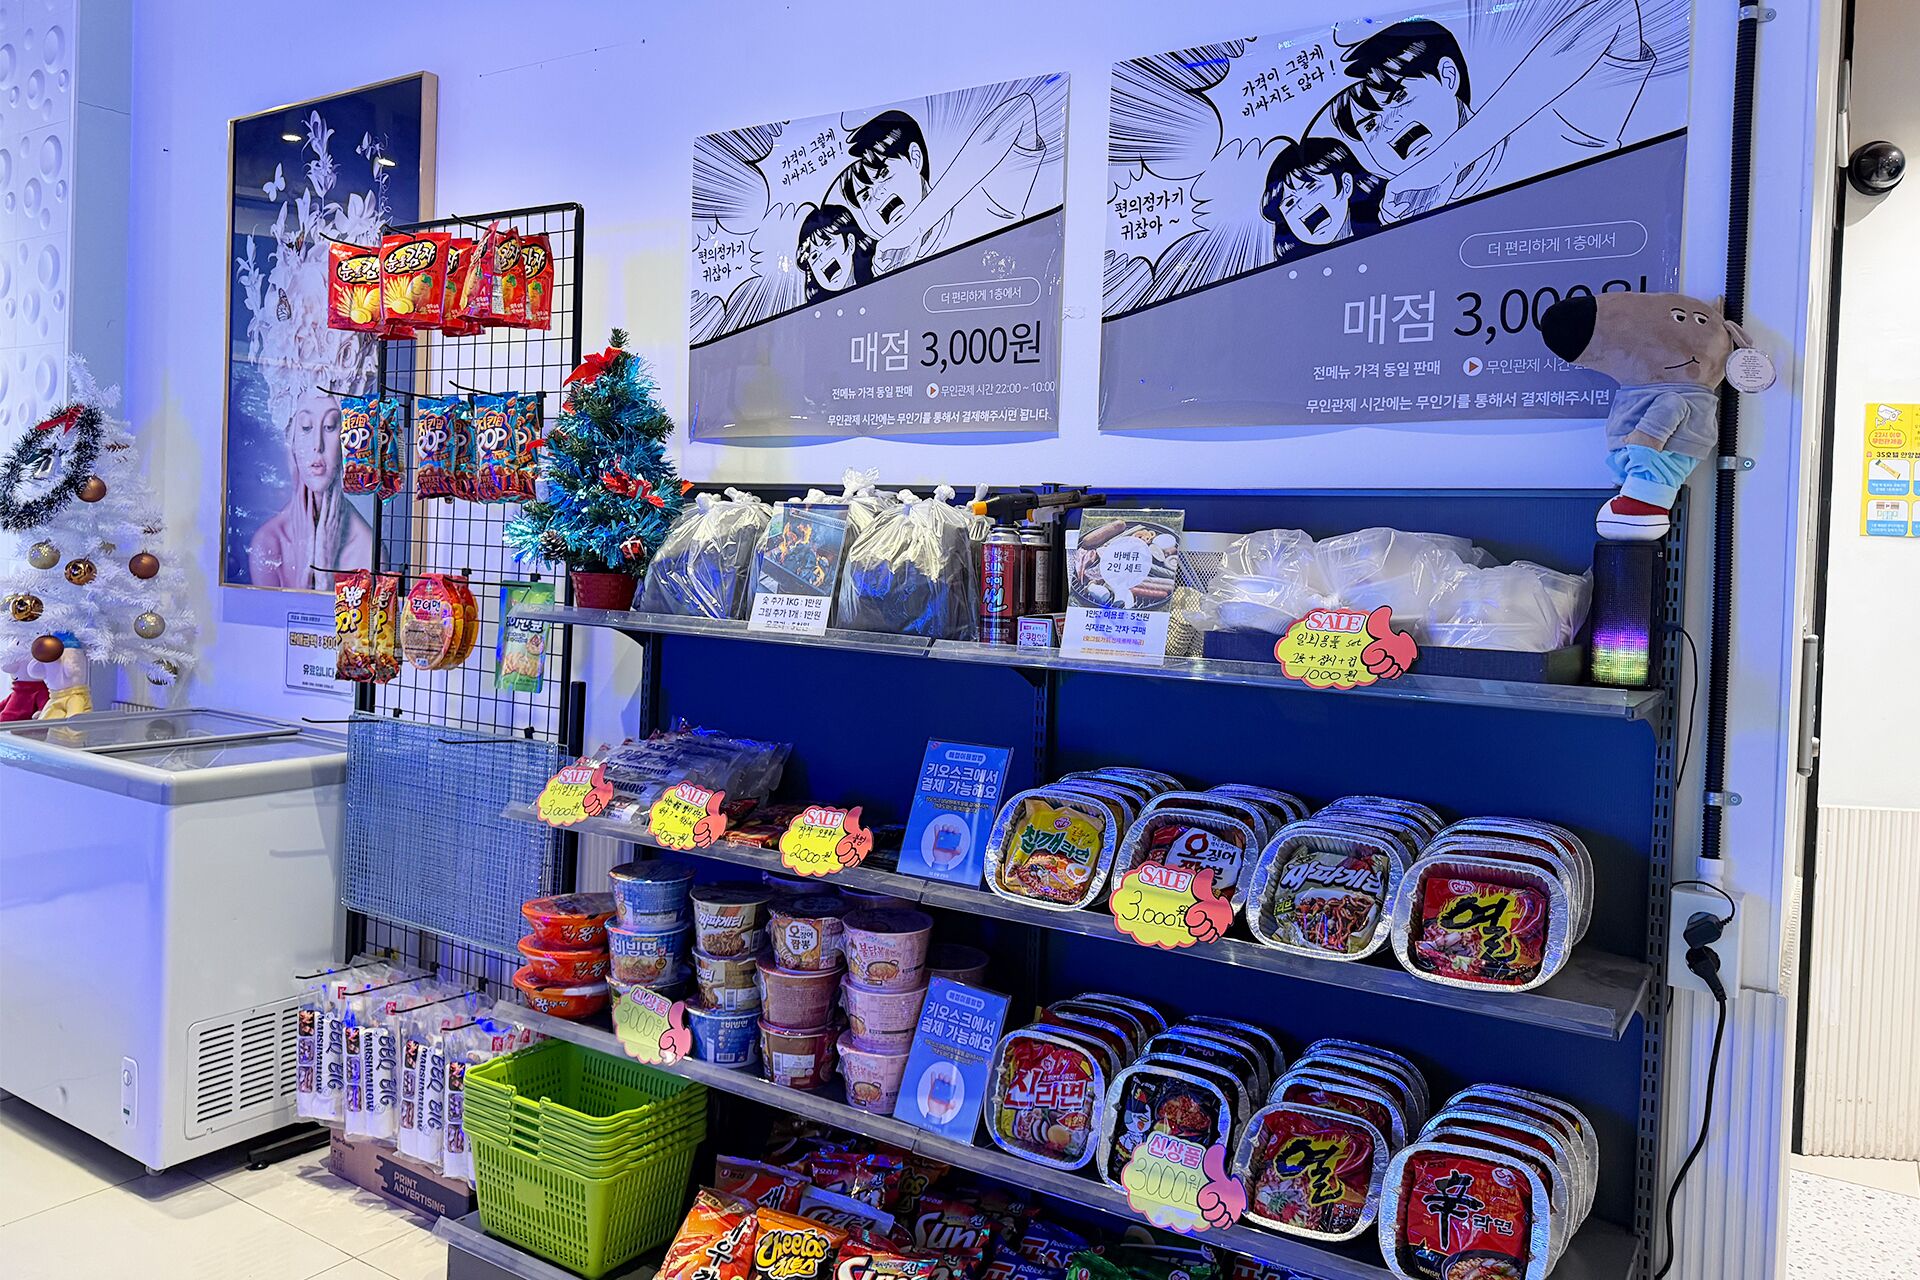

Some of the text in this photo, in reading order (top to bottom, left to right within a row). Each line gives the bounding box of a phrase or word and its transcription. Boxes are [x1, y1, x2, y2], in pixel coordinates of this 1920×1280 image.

[1242, 44, 1325, 98] 가격이 그렇게
[1242, 85, 1295, 118] 비싸지도
[781, 130, 837, 170] 가격이 그렇게
[782, 162, 817, 186] 비싸지도
[1114, 187, 1184, 219] 편의점가기
[1121, 216, 1163, 241] 귀찮아
[698, 240, 746, 265] 편의점가기
[1488, 232, 1618, 257] 더 편리하게 1층에서
[384, 243, 437, 273] 눈을감자
[703, 263, 732, 283] 귀찮아
[941, 287, 1022, 304] 더 편리하게 1층에서
[1344, 290, 1437, 346] 매점
[850, 321, 1042, 374] 매점 3,000원
[1313, 366, 1352, 382] 전메뉴
[1354, 364, 1381, 379] 가격
[1382, 362, 1411, 378] 동일
[1413, 360, 1441, 376] 판매
[1486, 358, 1541, 375] 무인관제
[831, 380, 1056, 400] 전메뉴 가격 동일 판매 무인관제 시간 22:00 10:00
[1306, 388, 1611, 414] 무인관제 시간에는 무인기를 통해서 결제해주시면
[827, 413, 861, 427] 무인관제
[862, 412, 896, 426] 시간에는
[897, 411, 932, 425] 무인기를
[932, 410, 961, 424] 통해서
[962, 408, 1018, 423] 결제해주시면
[1107, 563, 1142, 573] 2인 세트
[1113, 551, 1140, 562] 바베큐
[1309, 613, 1361, 631] SALE
[560, 771, 590, 782] SALE
[926, 763, 999, 784] 키오스크에서
[677, 786, 708, 805] SALE
[921, 777, 998, 799] 결제 가능해요
[805, 810, 844, 827] SALE
[1020, 823, 1091, 864] 참깨라면
[1177, 833, 1237, 866] 오징어
[1140, 866, 1188, 891] SALE
[698, 911, 745, 929] 짜파게티
[788, 925, 813, 939] 오징어
[614, 940, 657, 957] 비빔면
[926, 1001, 996, 1036] 키오스크에서
[921, 1016, 945, 1037] 결제
[946, 1024, 994, 1053] 가능해요
[364, 1031, 375, 1112] MARSHMALLOW
[1004, 1068, 1087, 1109] 진라면
[1149, 1134, 1203, 1169] 신상품
[393, 1171, 418, 1188] PRINT
[393, 1184, 446, 1215] ADVERTISING
[1422, 1169, 1486, 1251] 辛
[1472, 1214, 1514, 1236] 라면
[914, 1211, 976, 1251] Sun
[756, 1229, 830, 1268] Cheetos
[770, 1258, 817, 1277] 치토스
